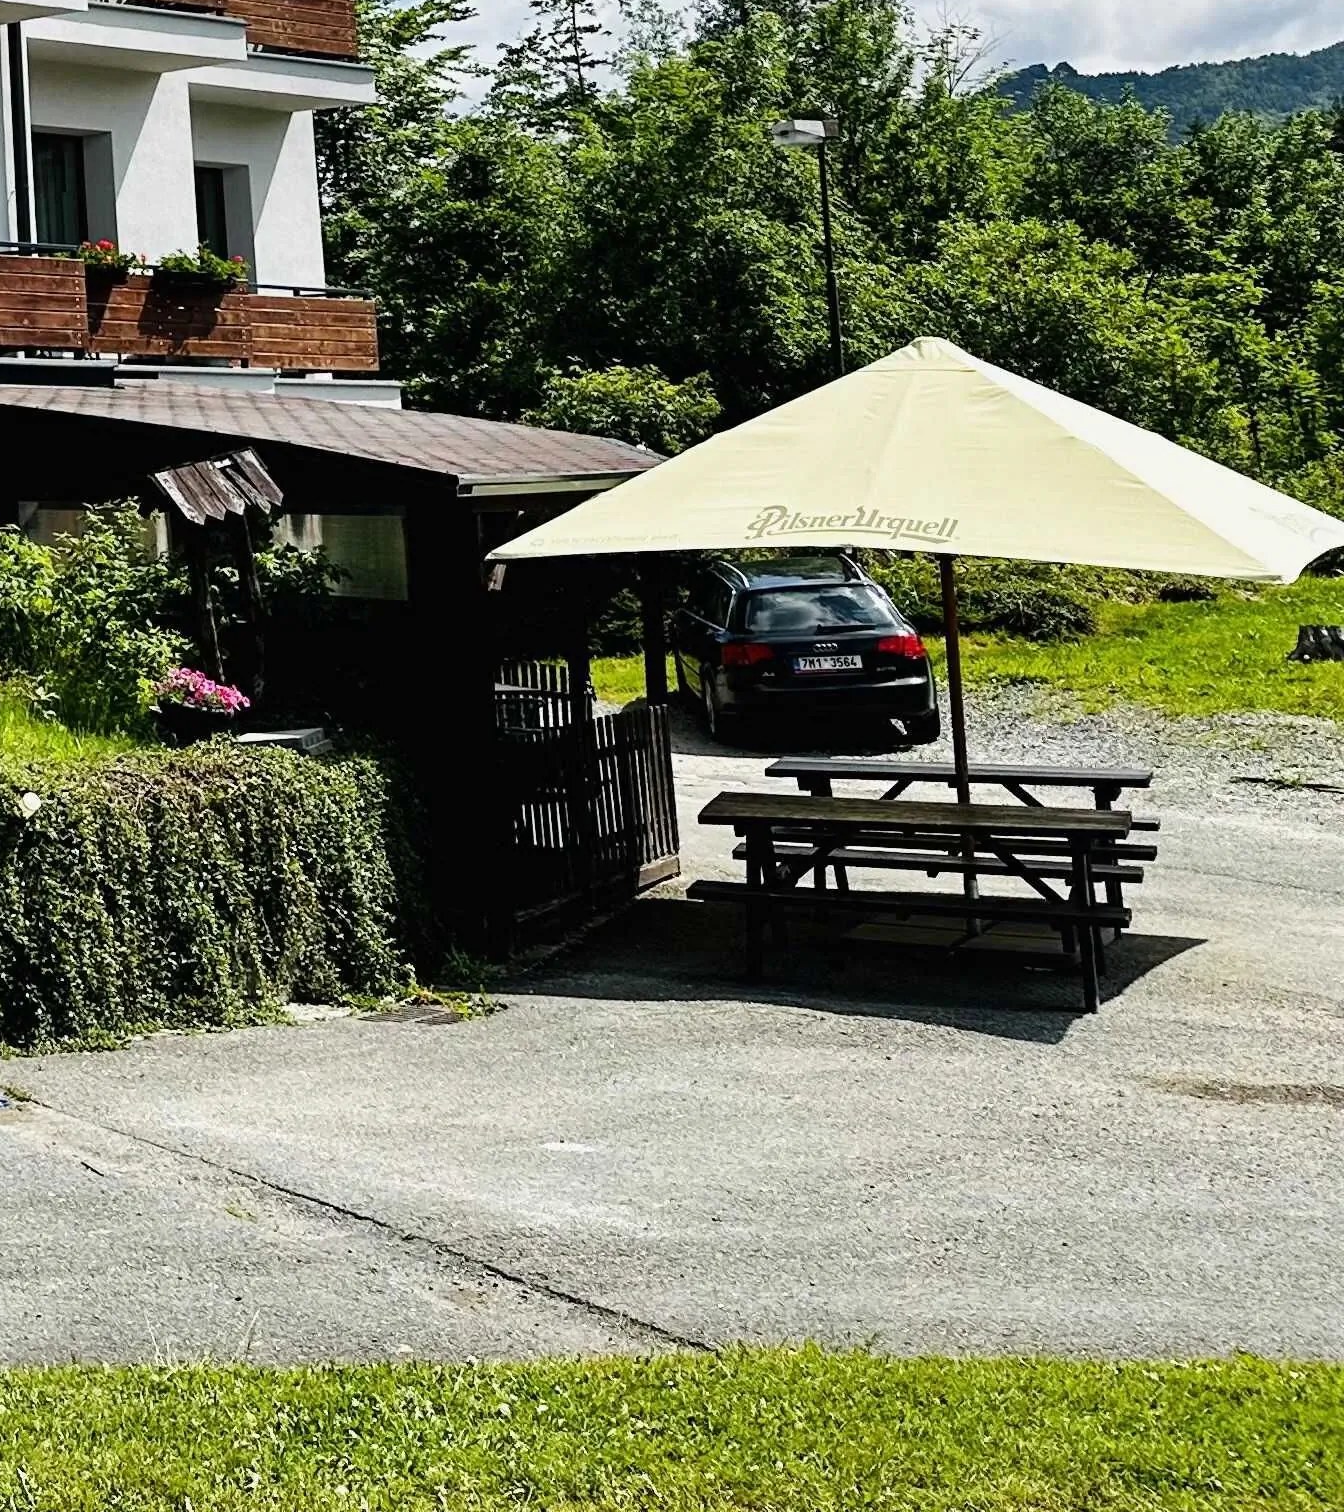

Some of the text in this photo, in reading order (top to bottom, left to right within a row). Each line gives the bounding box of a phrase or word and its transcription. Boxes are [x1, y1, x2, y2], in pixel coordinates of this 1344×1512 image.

[744, 504, 960, 540] Pilsner Urquell
[830, 656, 857, 668] 3564
